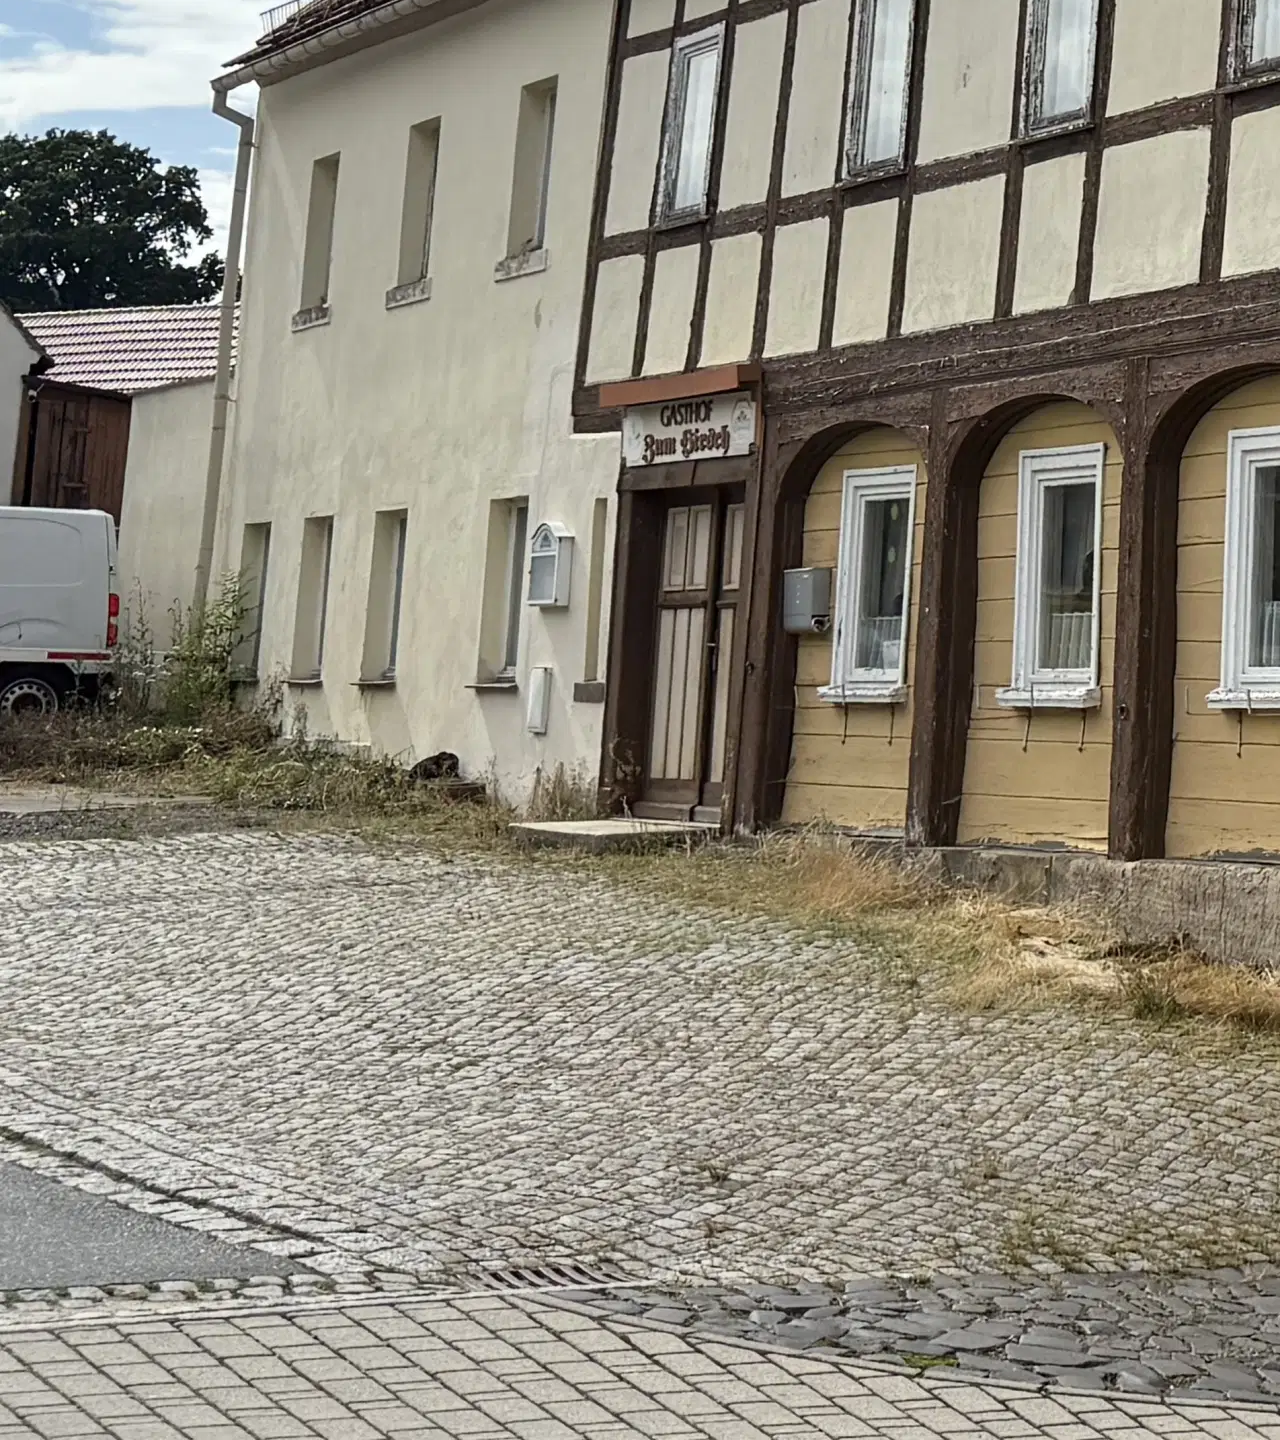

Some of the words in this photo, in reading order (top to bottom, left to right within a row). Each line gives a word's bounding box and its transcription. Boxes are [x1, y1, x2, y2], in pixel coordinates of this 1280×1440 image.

[660, 399, 714, 427] GASTHOF
[642, 434, 676, 464] Zum
[680, 425, 730, 458] Hirsch
